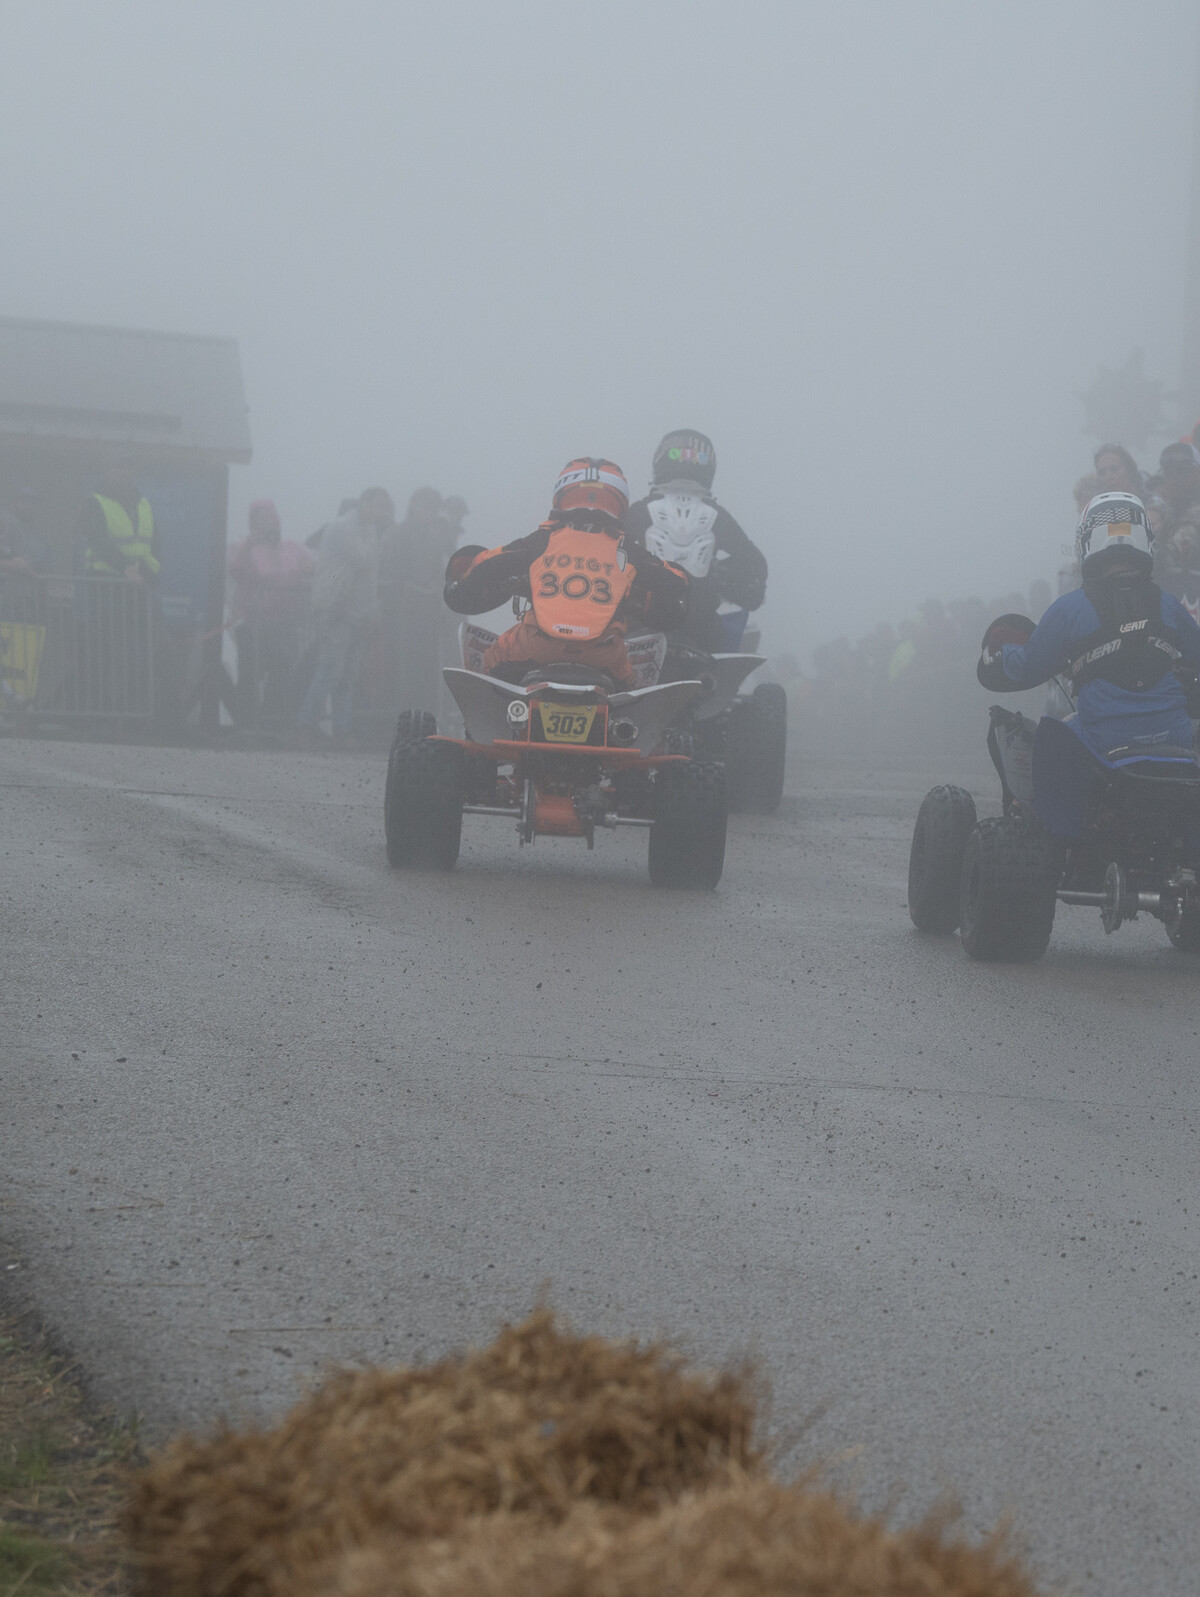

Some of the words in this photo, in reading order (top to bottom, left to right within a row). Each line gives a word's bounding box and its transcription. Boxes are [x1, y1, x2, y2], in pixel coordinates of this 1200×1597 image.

[542, 553, 615, 577] VOIGT
[537, 570, 613, 605] 303
[1120, 619, 1148, 633] LEATT
[547, 715, 588, 735] 303
